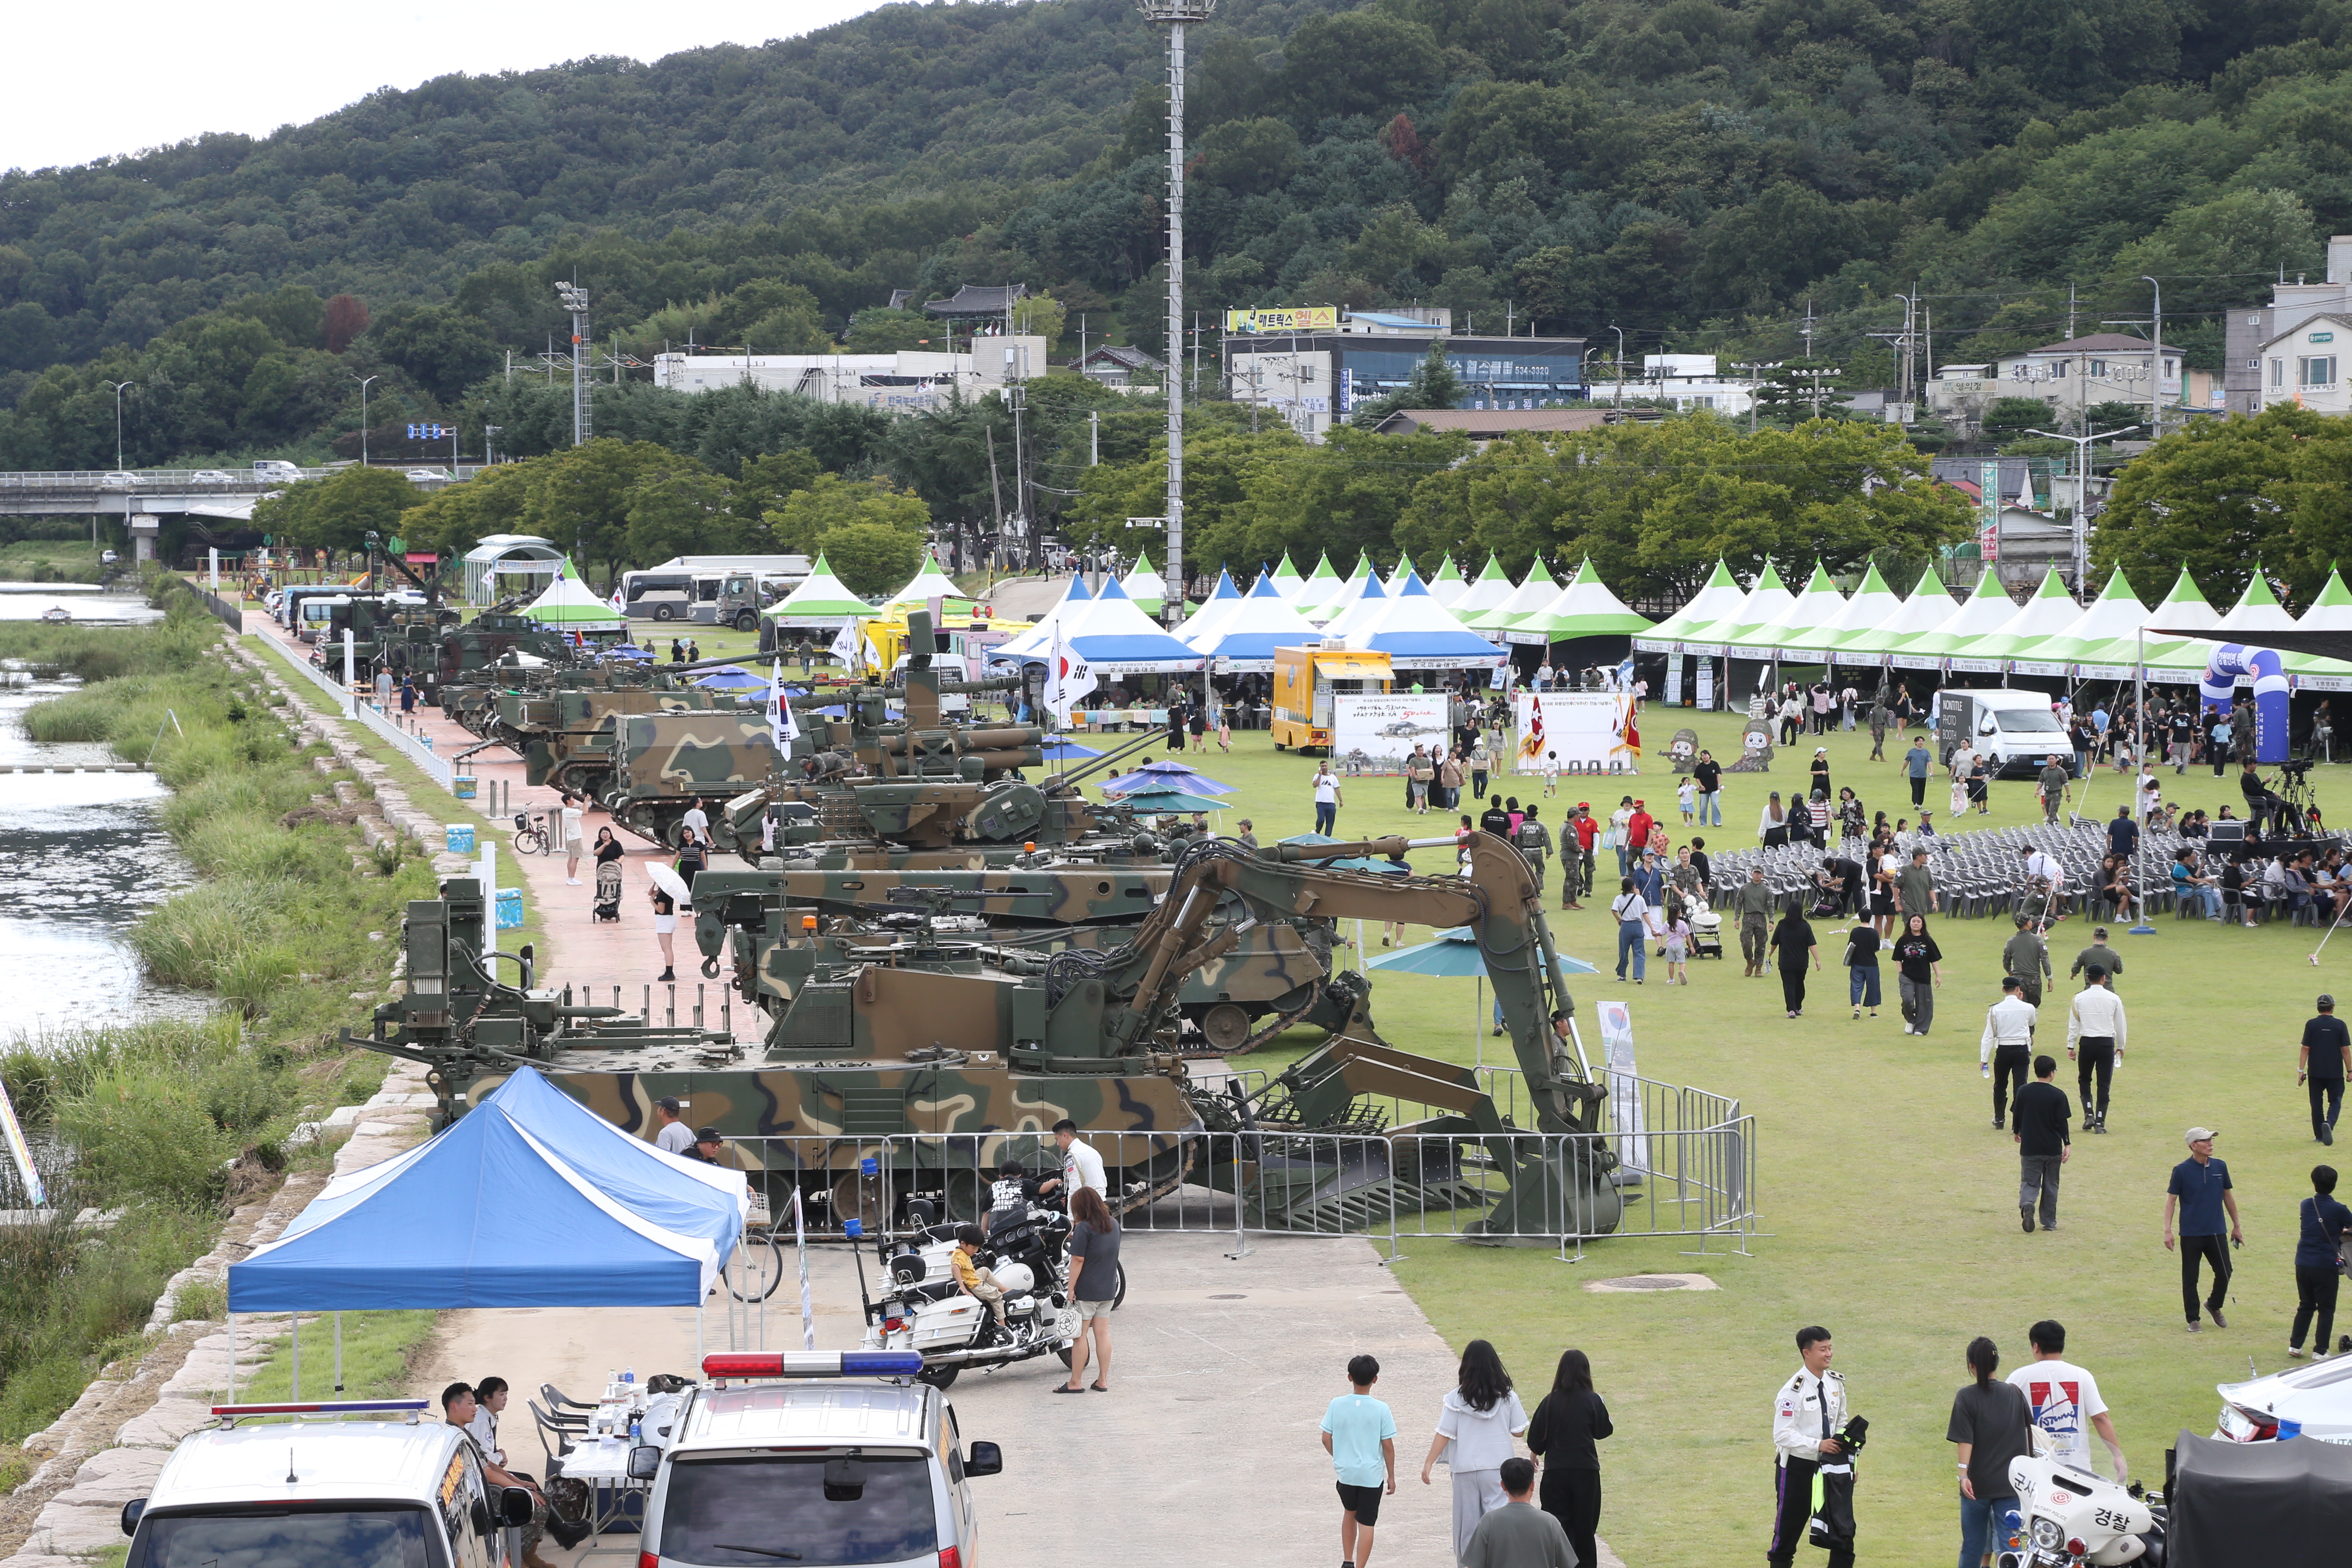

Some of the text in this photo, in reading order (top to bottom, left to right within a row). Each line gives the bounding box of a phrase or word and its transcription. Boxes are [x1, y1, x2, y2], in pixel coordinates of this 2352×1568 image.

[1258, 310, 1330, 327] 매트릭스 헬스
[1515, 366, 1549, 375] 534-3320
[1943, 700, 1962, 711] NONTITLE
[1943, 714, 1956, 726] PHOTO
[2259, 712, 2264, 723] 다시
[1942, 729, 1956, 740] BOOTH
[2014, 1472, 2037, 1498] 군사
[2051, 1510, 2068, 1522] POLICE
[2094, 1507, 2131, 1533] 경찰
